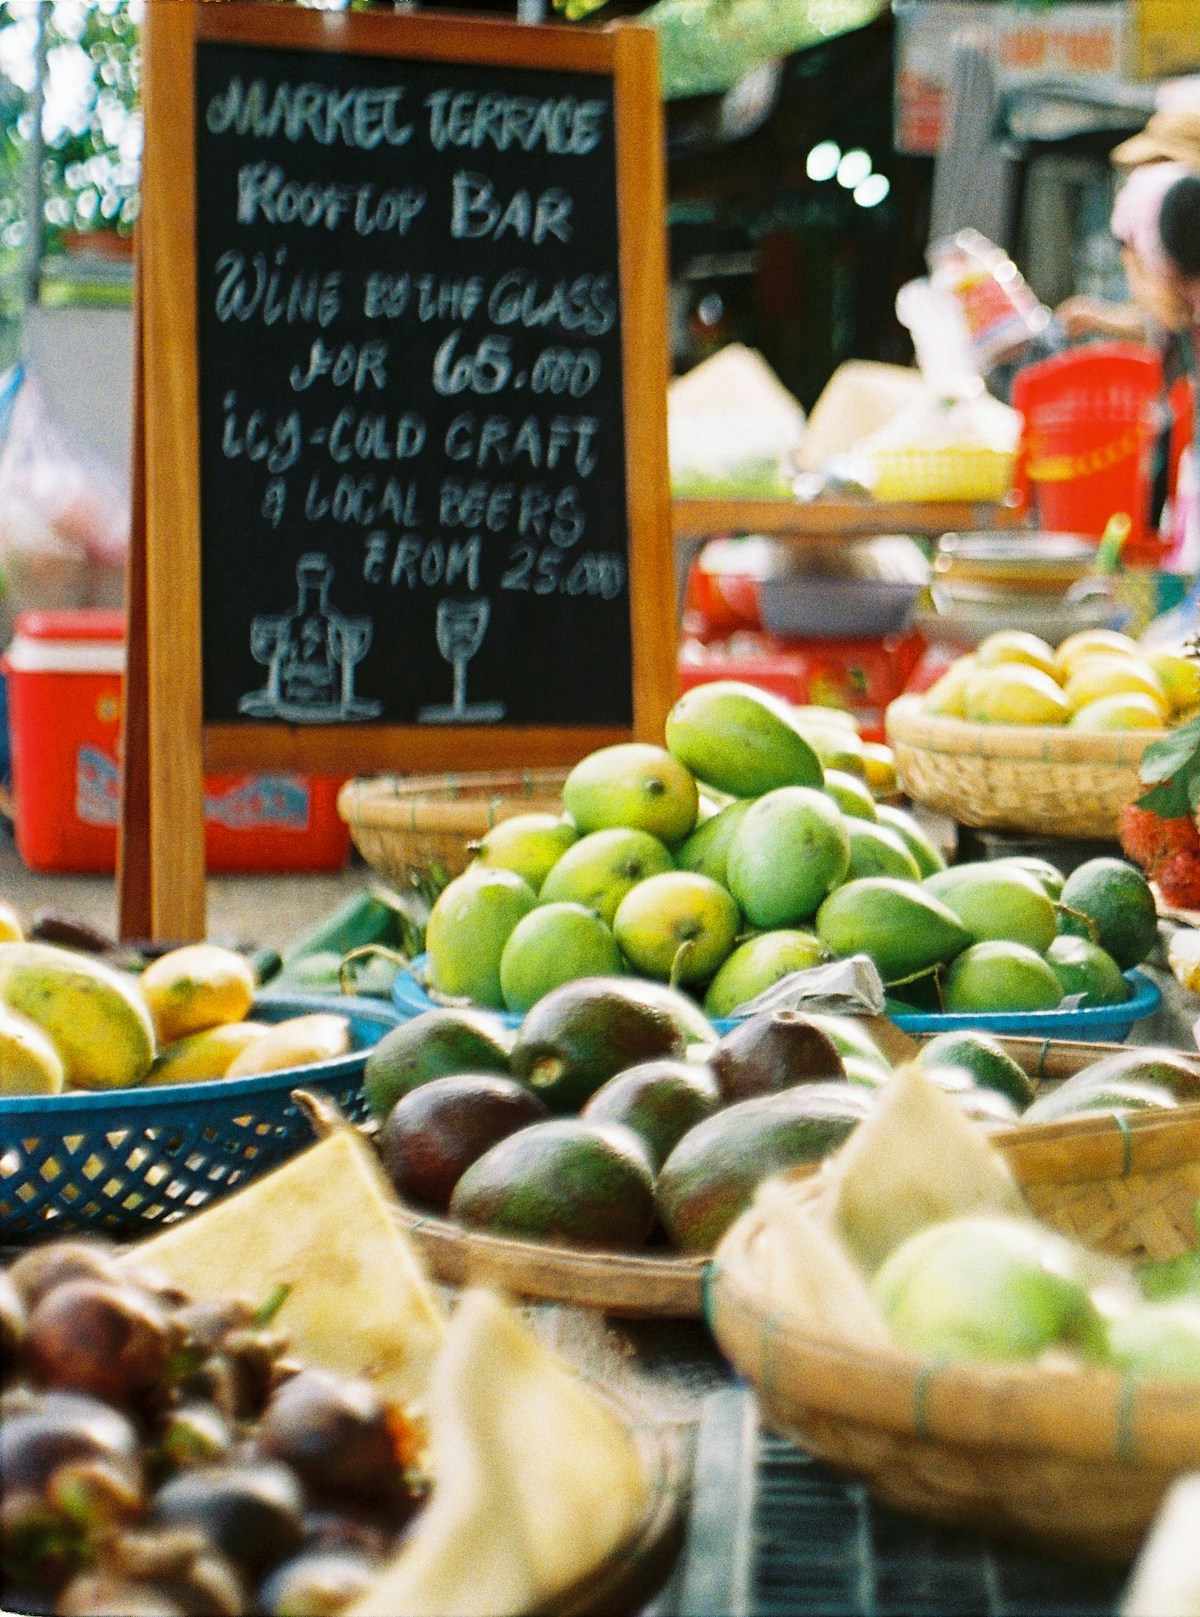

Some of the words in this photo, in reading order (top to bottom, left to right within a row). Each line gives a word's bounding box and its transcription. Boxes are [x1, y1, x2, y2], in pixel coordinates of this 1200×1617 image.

[206, 74, 413, 150] MARKET
[424, 88, 606, 155] TERRACE
[451, 168, 573, 244] BAR
[488, 267, 617, 336] GLASS
[290, 337, 388, 393] FOR
[433, 328, 601, 398] 65.000
[445, 411, 599, 478] CRAFT
[304, 470, 418, 527] LOCAL
[439, 475, 586, 548] BEERS
[362, 530, 482, 590] FROM
